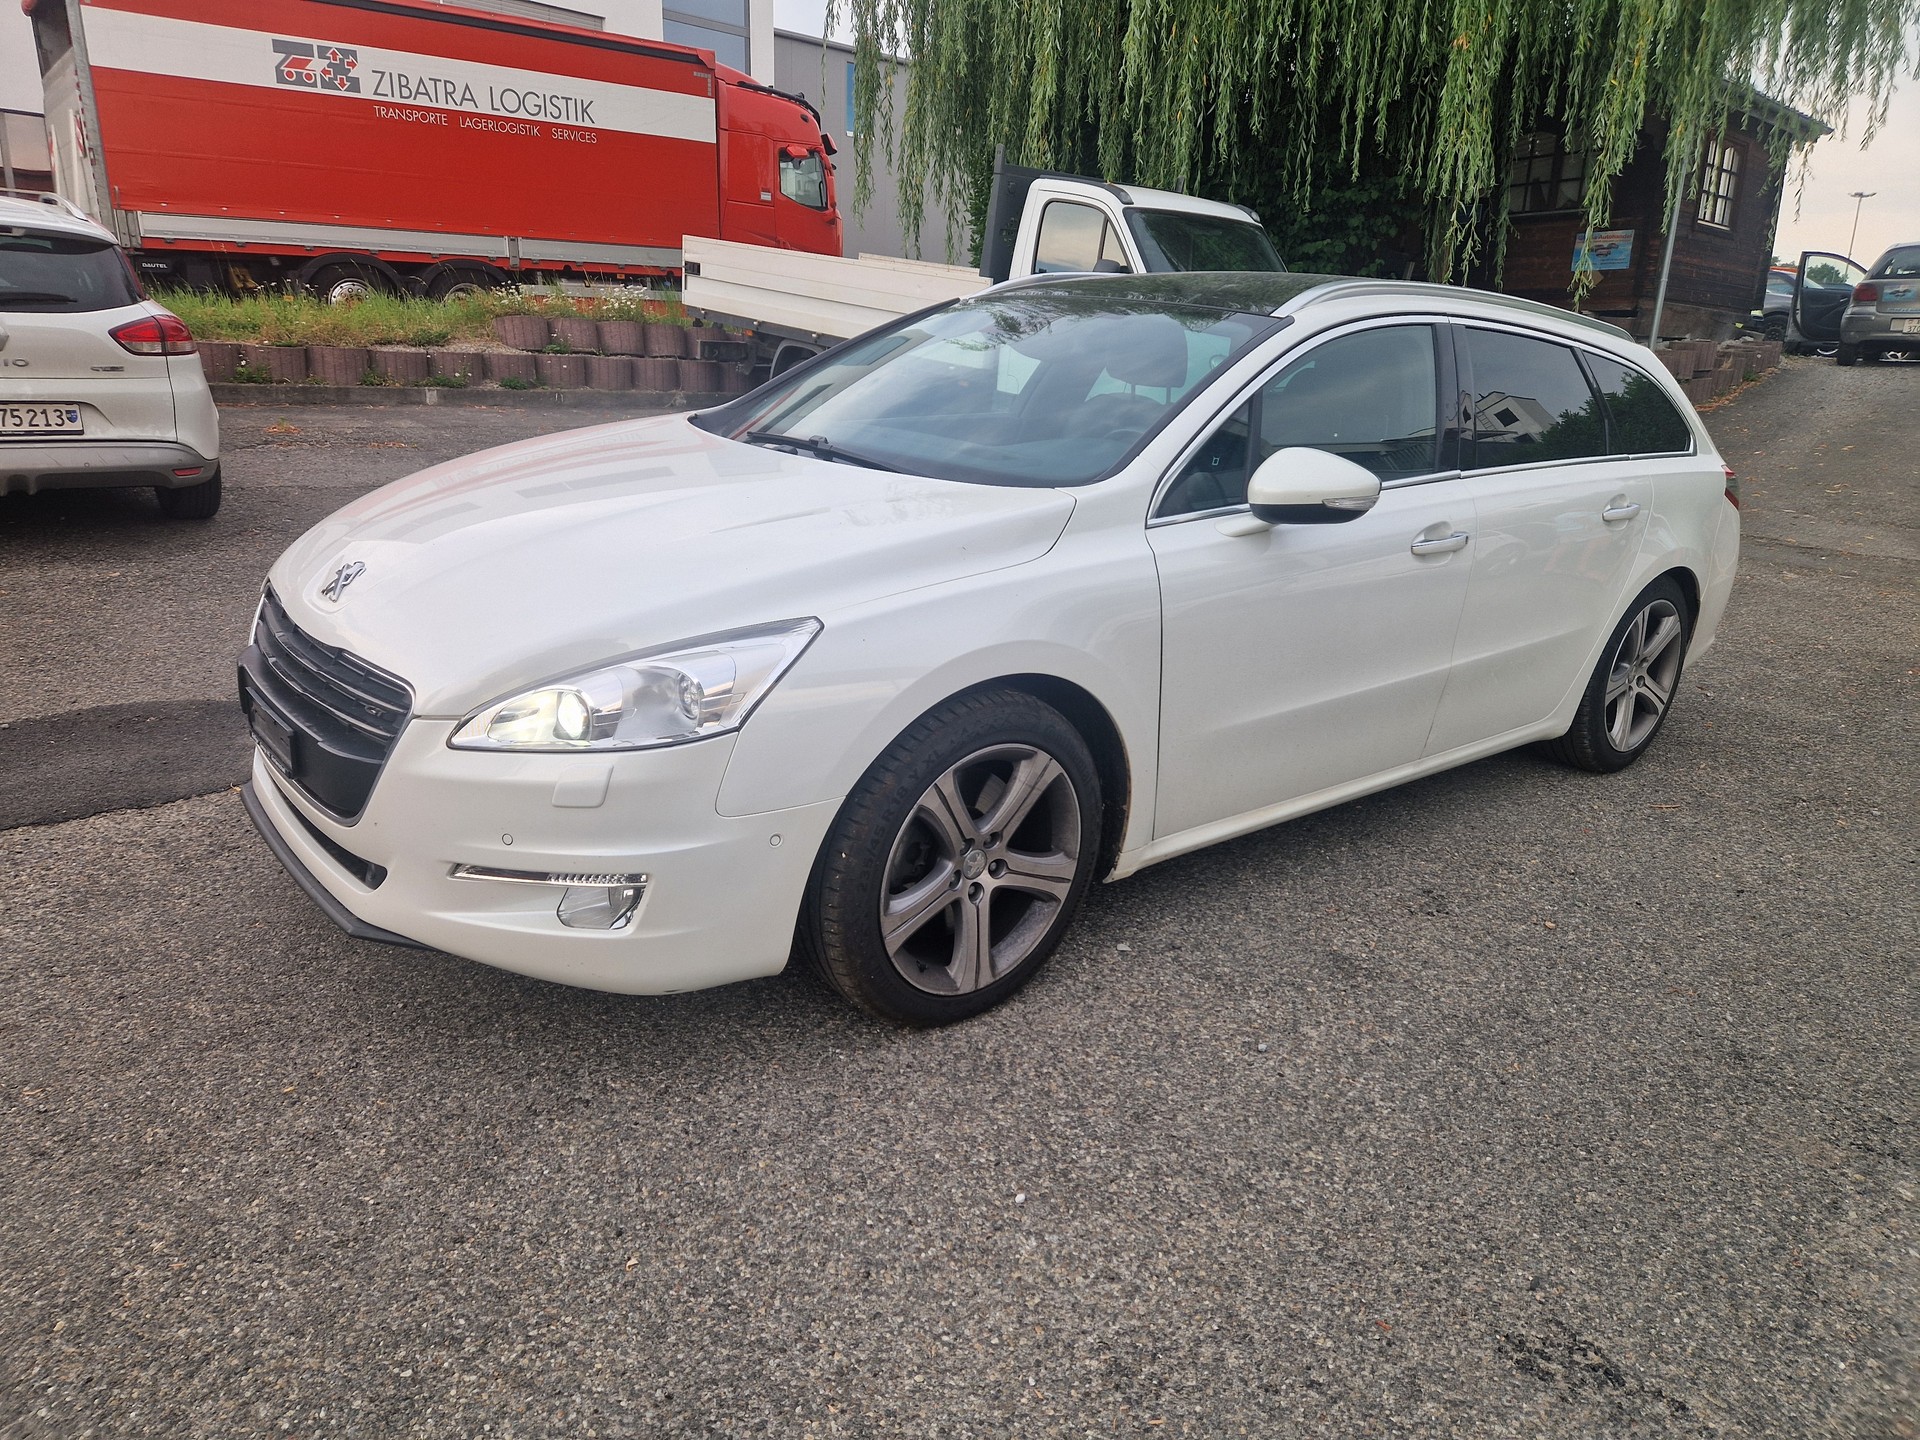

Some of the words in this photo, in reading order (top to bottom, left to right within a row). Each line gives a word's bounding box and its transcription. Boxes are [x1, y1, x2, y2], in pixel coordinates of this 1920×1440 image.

[372, 70, 479, 109] ZIBATRA
[489, 85, 595, 124] LOGISTIK
[373, 105, 448, 126] TRANSPORTE
[459, 116, 541, 137] LAGERLOGISTIK
[551, 128, 597, 144] SERVICES
